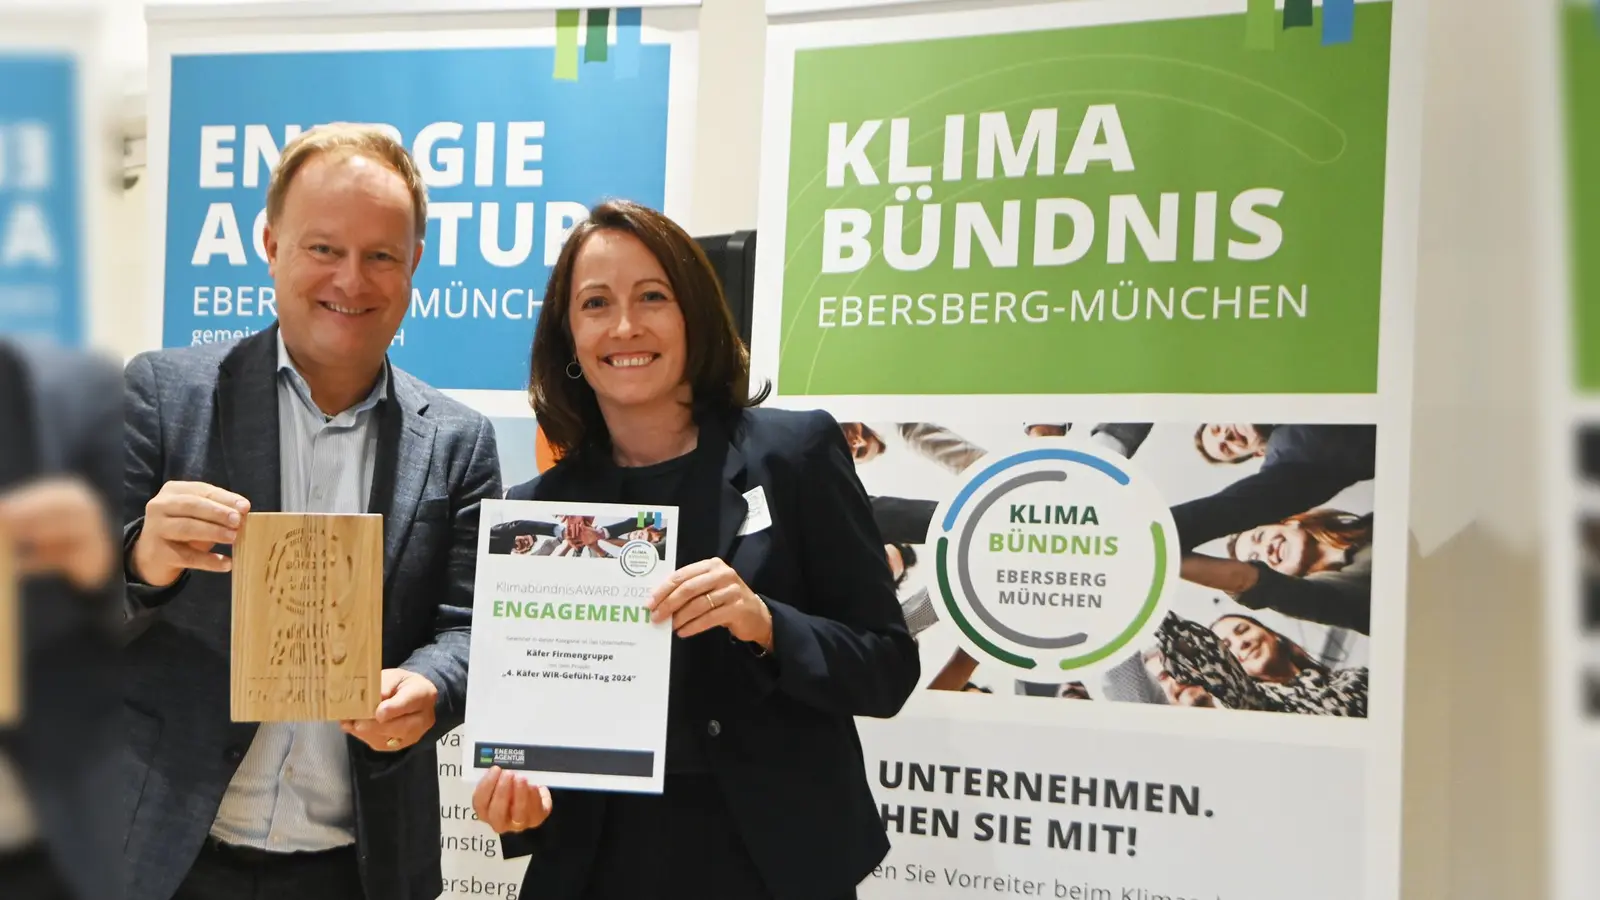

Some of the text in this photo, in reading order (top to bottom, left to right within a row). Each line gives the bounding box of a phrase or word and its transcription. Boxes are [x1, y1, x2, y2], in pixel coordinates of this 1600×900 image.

[199, 121, 545, 188] ENGIE
[825, 104, 1135, 189] KLIMA
[821, 185, 1285, 274] BÜNDNIS
[818, 280, 1310, 329] EBERSBERG-MÜNCHEN
[1009, 504, 1100, 526] KLIMA
[989, 528, 1118, 555] BÜNDNIS
[996, 569, 1107, 587] EBERSBERG
[493, 601, 651, 623] ENGAGEMENT
[998, 588, 1103, 609] MÜNCHEN
[526, 649, 614, 661] Käfer Firmengruppe
[516, 669, 540, 677] Käfer
[879, 760, 1214, 818] UNTERNEHMEN.
[973, 811, 1032, 847] SIE
[1047, 819, 1138, 857] MIT!
[904, 863, 936, 884] Sie
[943, 867, 1046, 895] Vorreiter
[1054, 878, 1111, 900] beim
